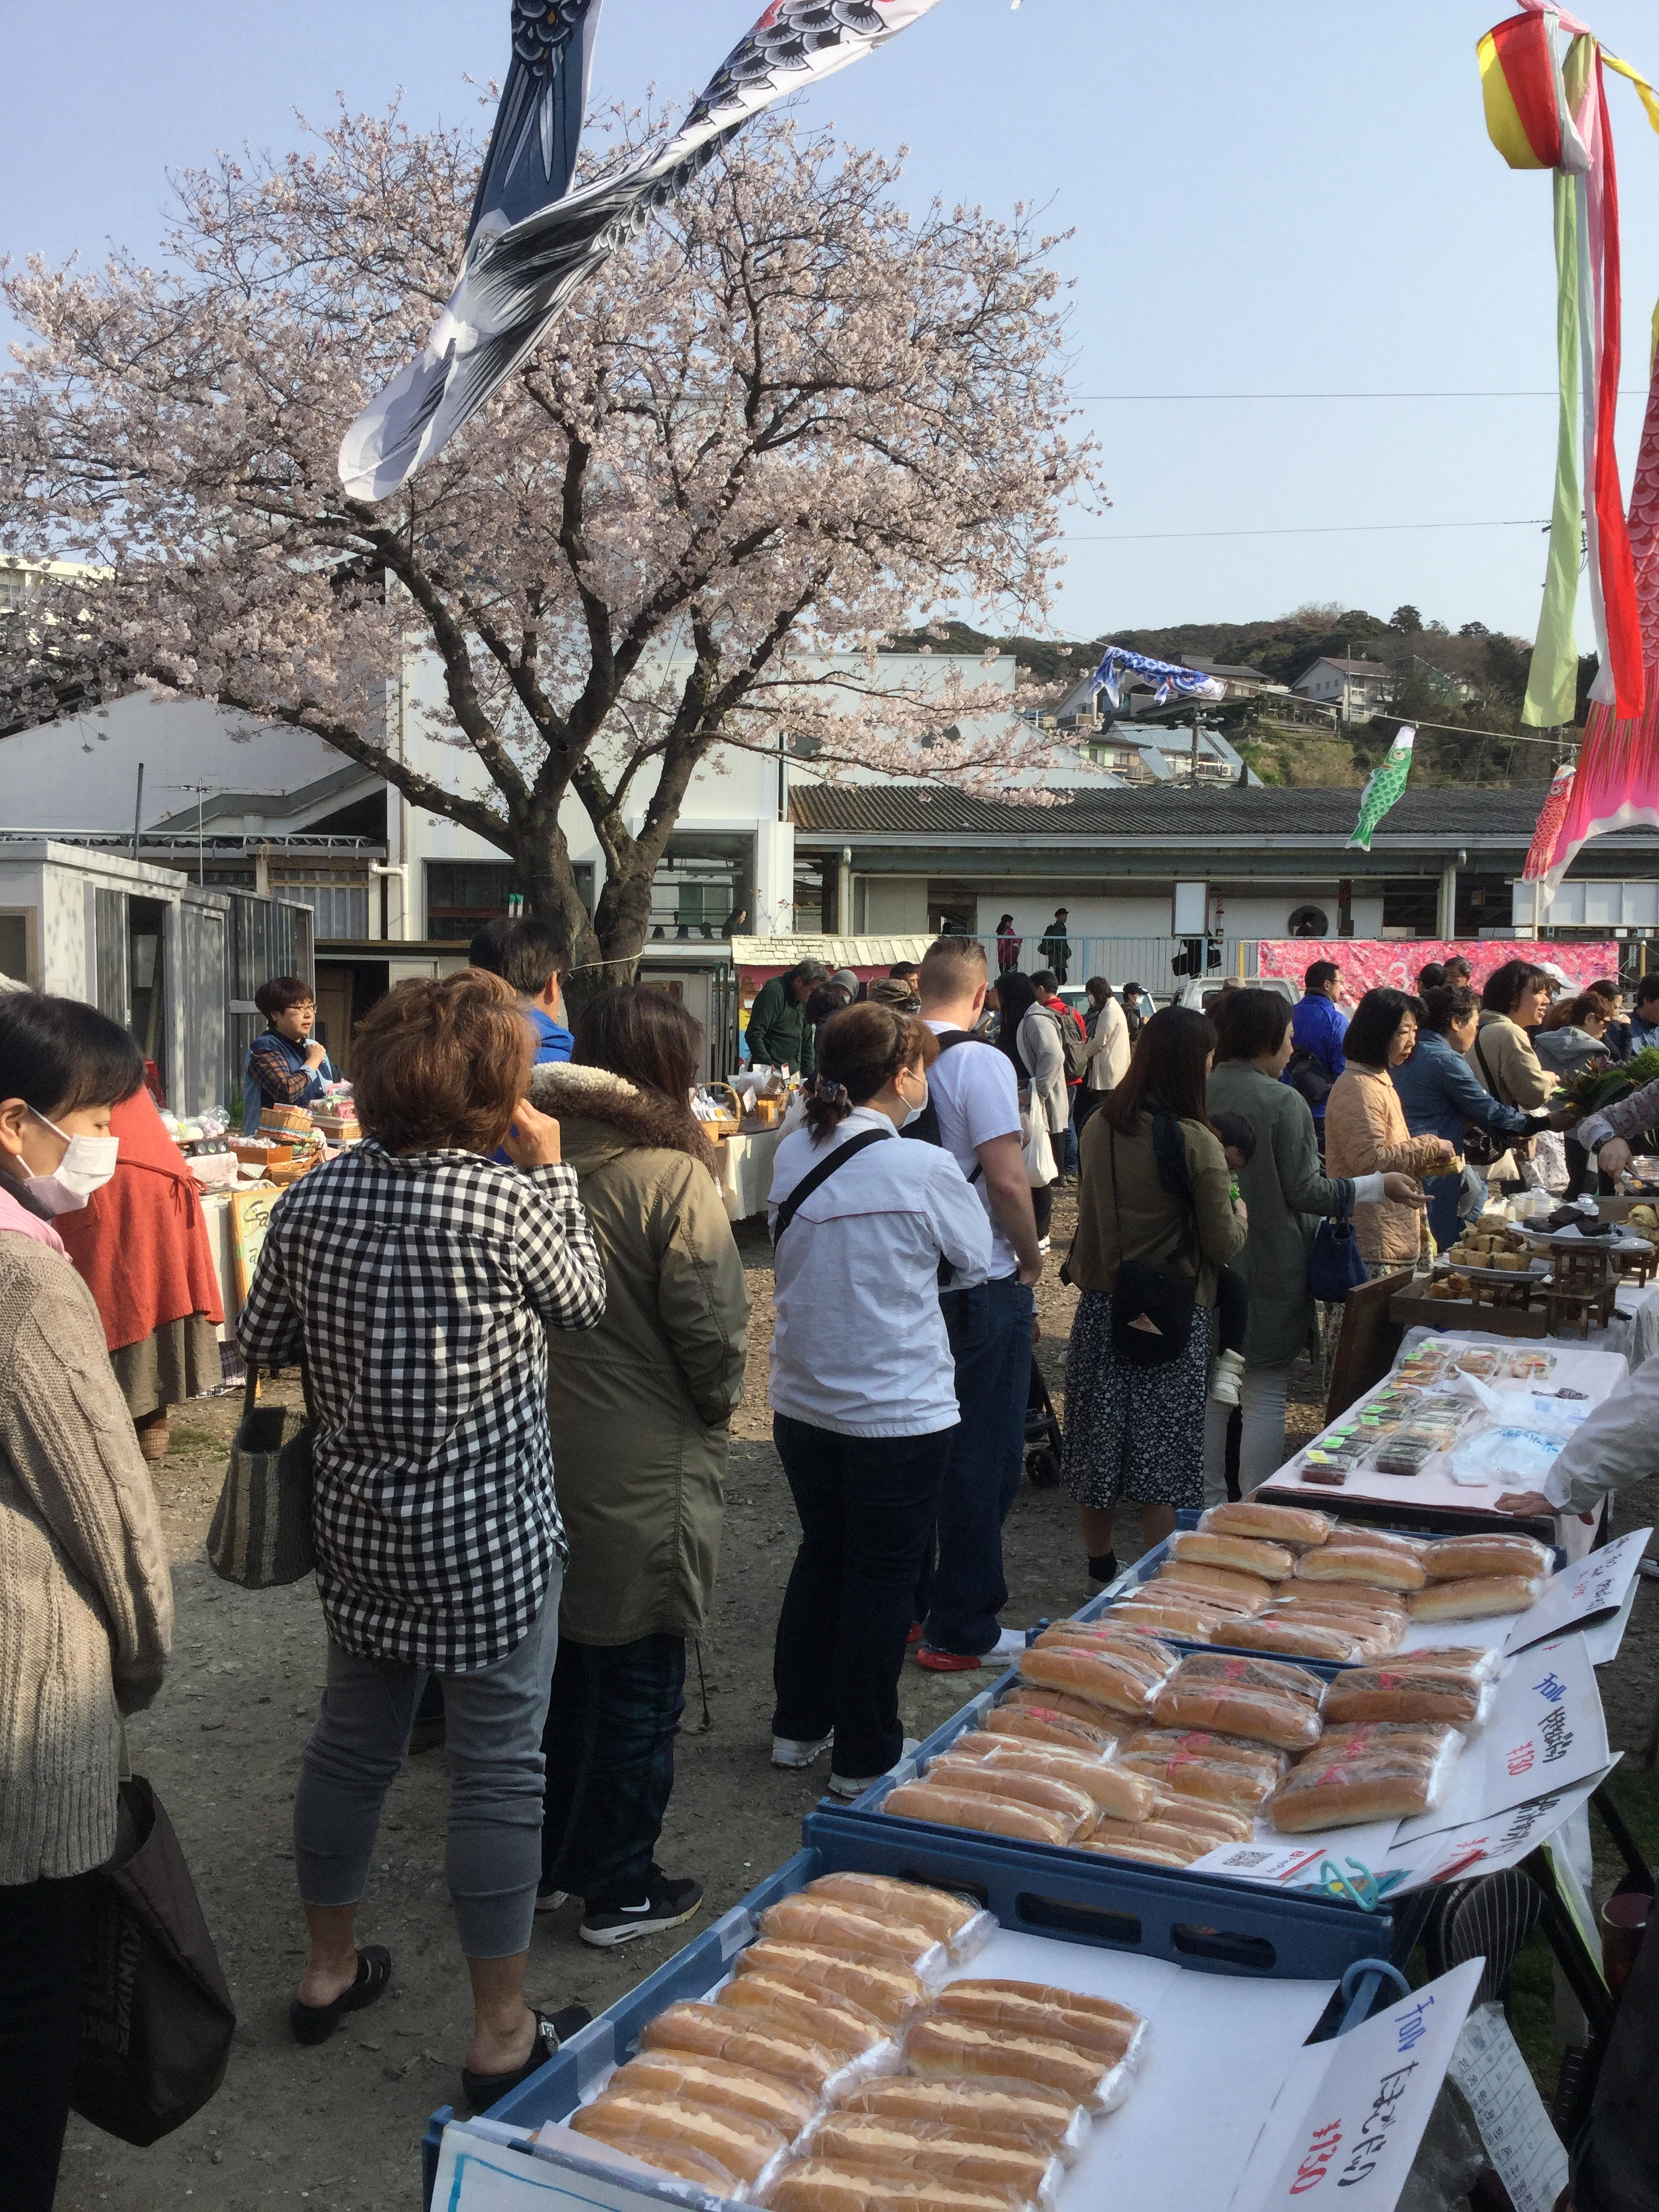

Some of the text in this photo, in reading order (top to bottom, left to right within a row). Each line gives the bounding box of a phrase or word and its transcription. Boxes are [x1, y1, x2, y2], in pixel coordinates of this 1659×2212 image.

[1506, 1740, 1535, 1776] ¥130
[1266, 1857, 1297, 1875] PayPay
[1288, 2118, 1343, 2195] ¥130
